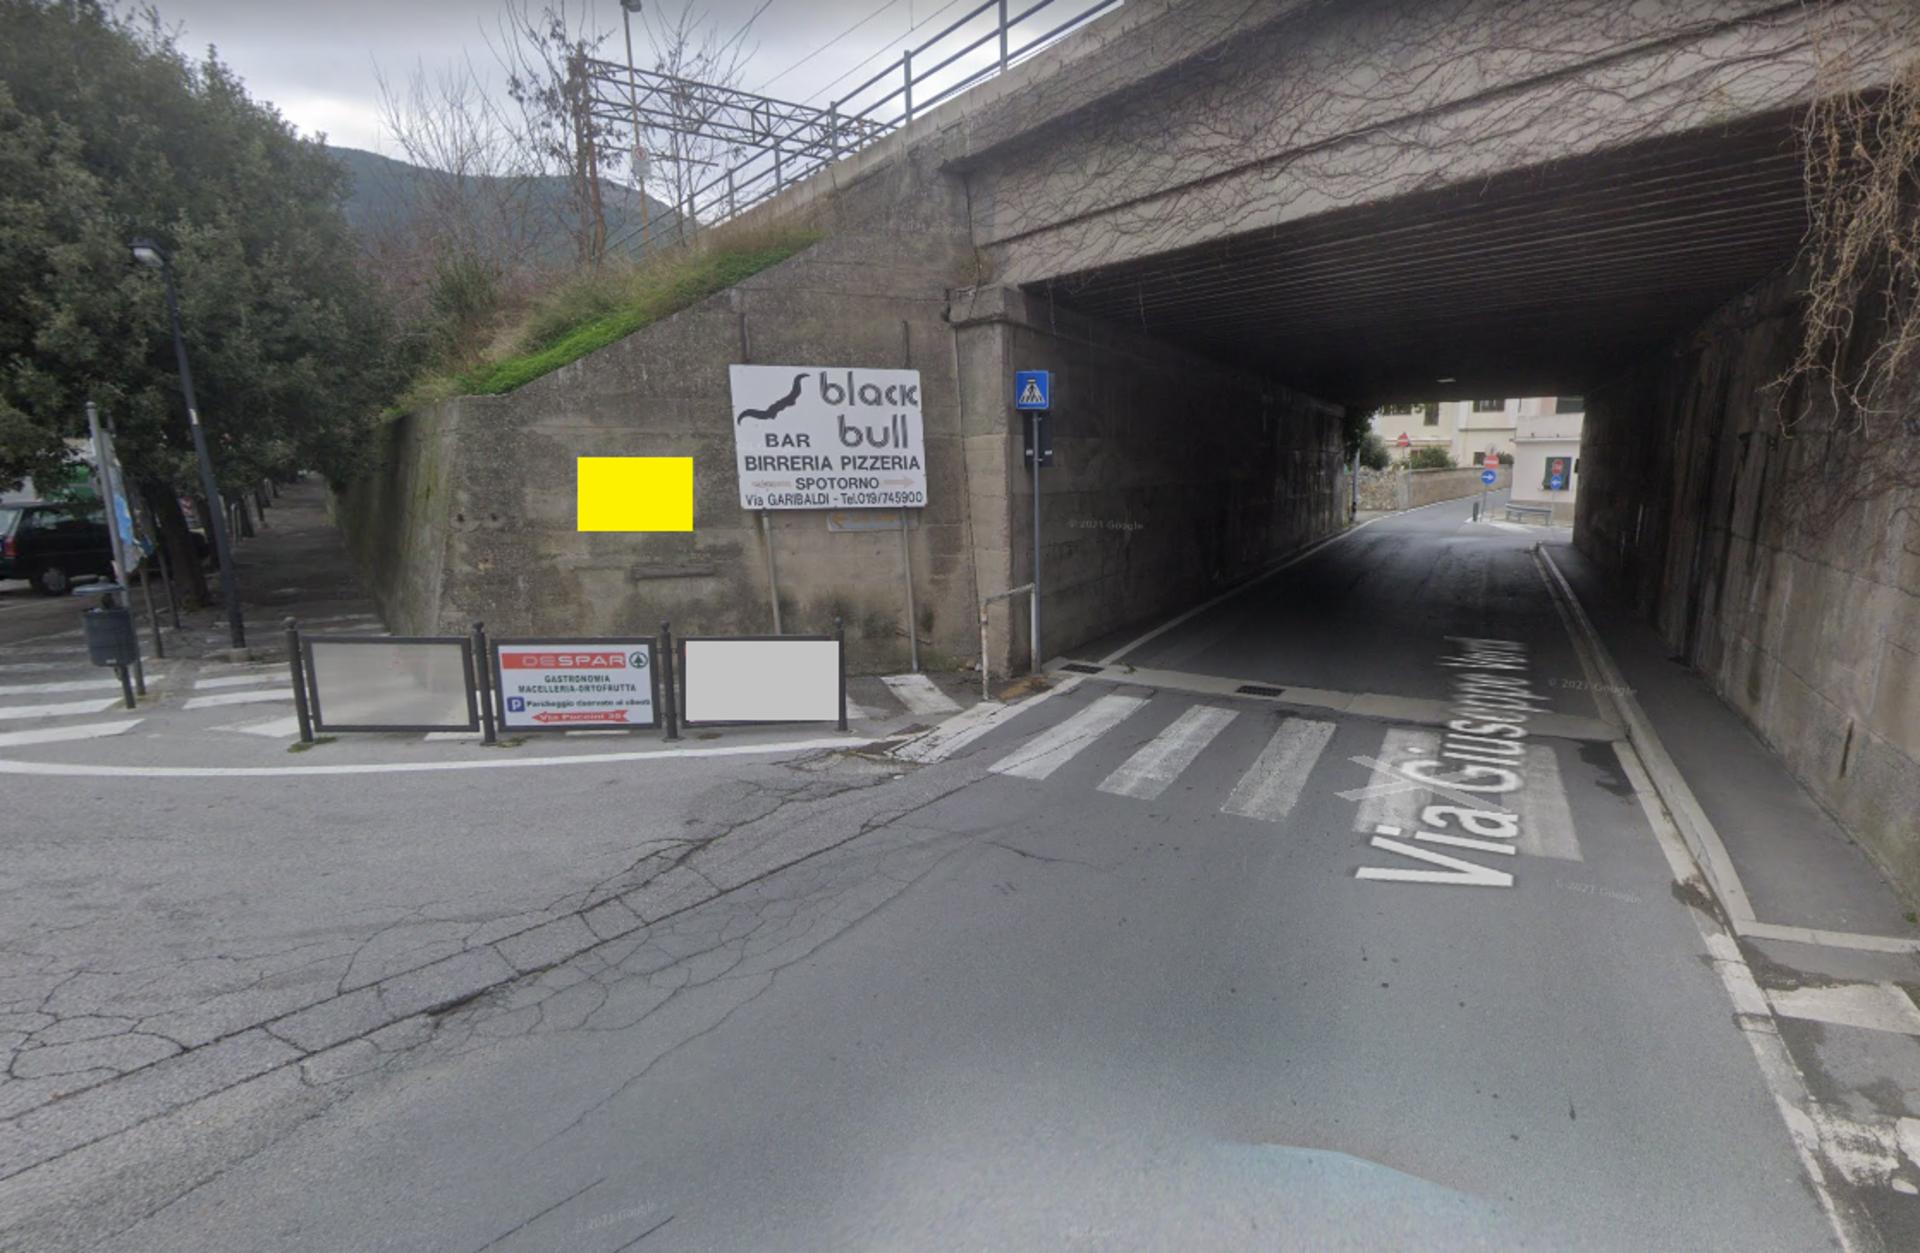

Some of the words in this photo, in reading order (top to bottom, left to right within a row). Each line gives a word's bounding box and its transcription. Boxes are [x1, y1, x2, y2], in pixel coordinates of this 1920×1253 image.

[820, 371, 918, 406] black
[837, 414, 908, 448] bull
[765, 433, 811, 447] BAR
[745, 455, 833, 471] BIRRERIA
[841, 455, 921, 471] PIZZERIA
[795, 477, 879, 490] SPOTORNO
[745, 494, 764, 505] Via
[768, 492, 829, 505] GARIBALDI
[522, 654, 625, 668] DESPAR
[544, 674, 610, 683] GASTRONOMIA
